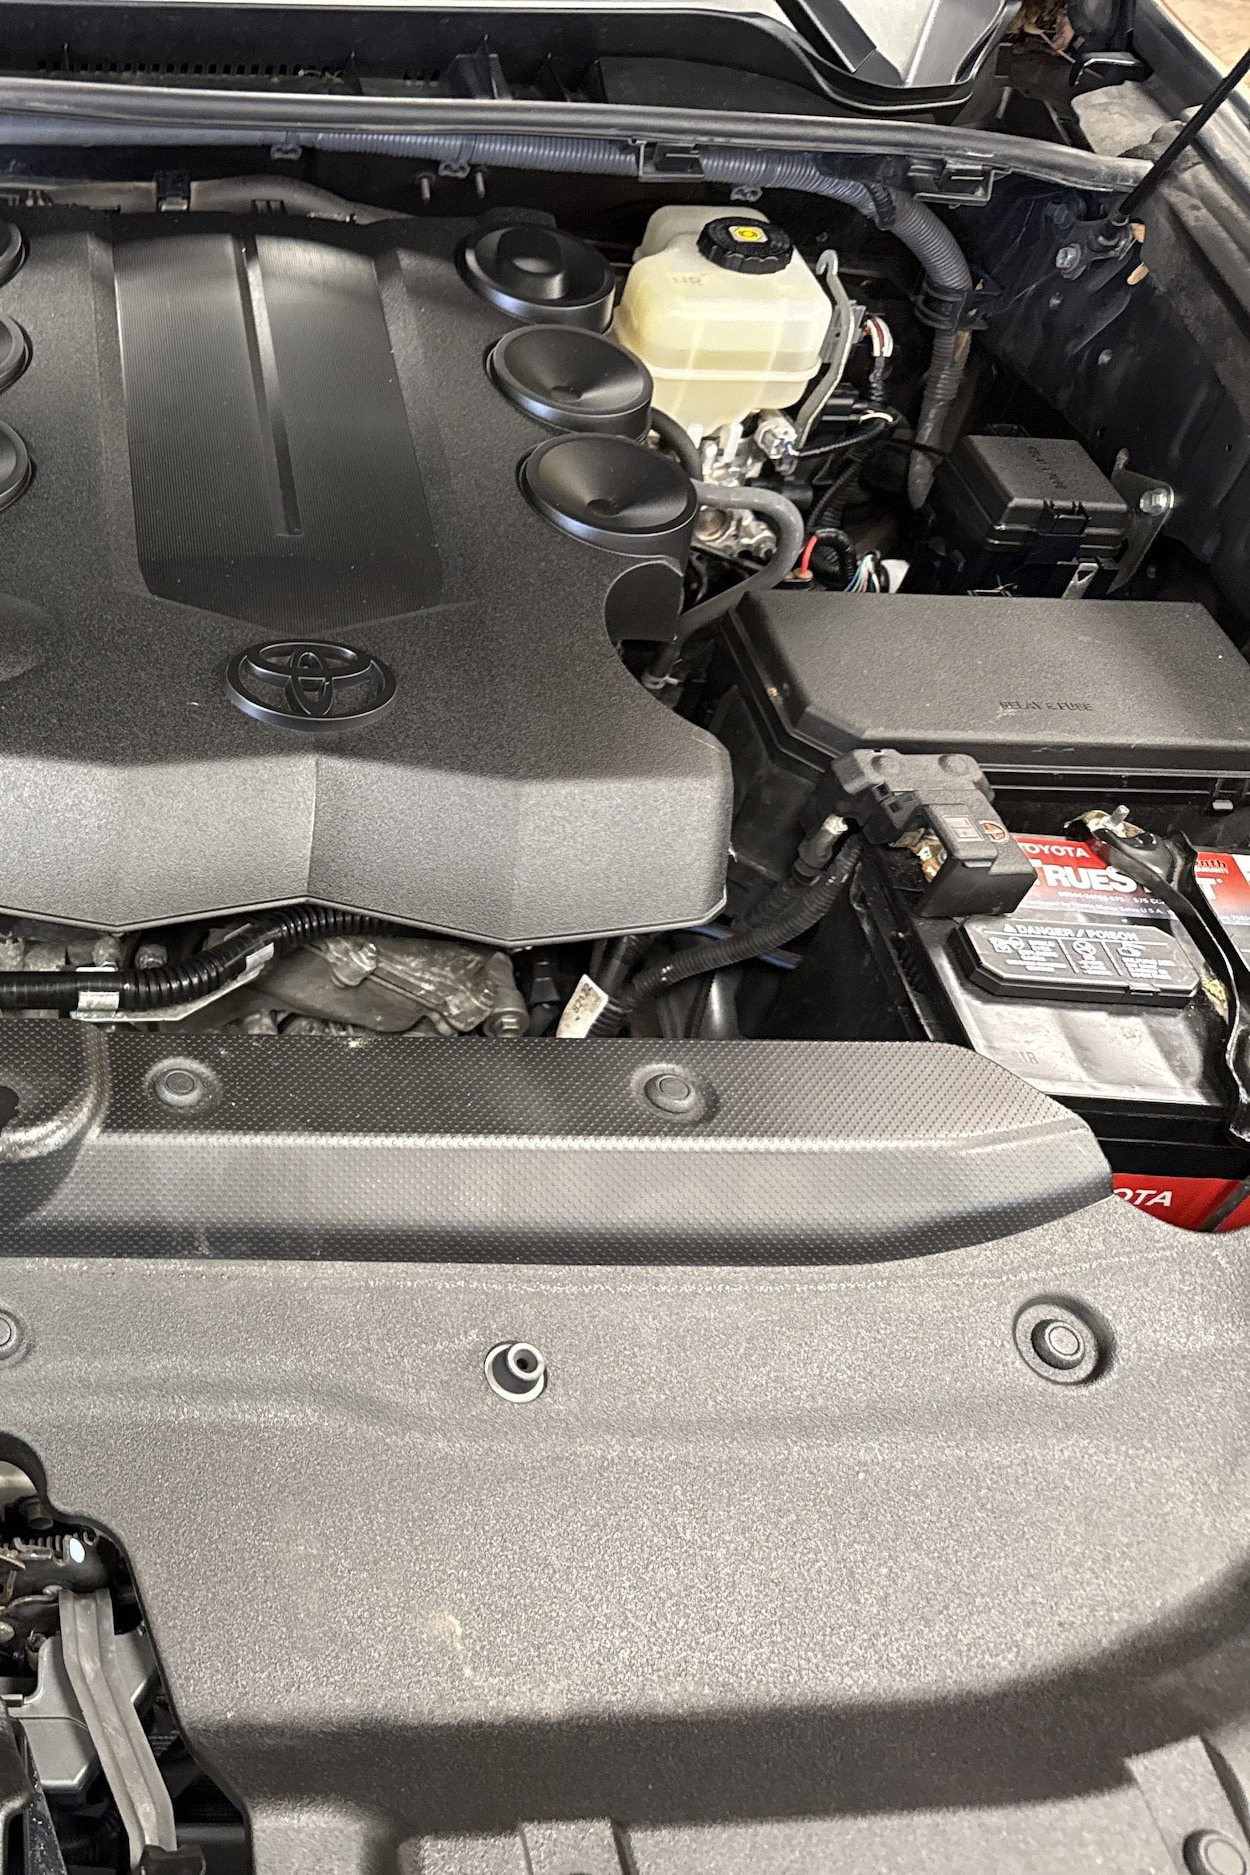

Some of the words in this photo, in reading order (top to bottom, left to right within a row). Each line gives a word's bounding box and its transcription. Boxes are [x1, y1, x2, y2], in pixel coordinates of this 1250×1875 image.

[1000, 700, 1042, 710] RELAY
[1057, 702, 1093, 711] FUSE
[1018, 842, 1091, 858] TOYOTA
[1016, 924, 1073, 938] DANGER
[1085, 928, 1140, 941] POISON
